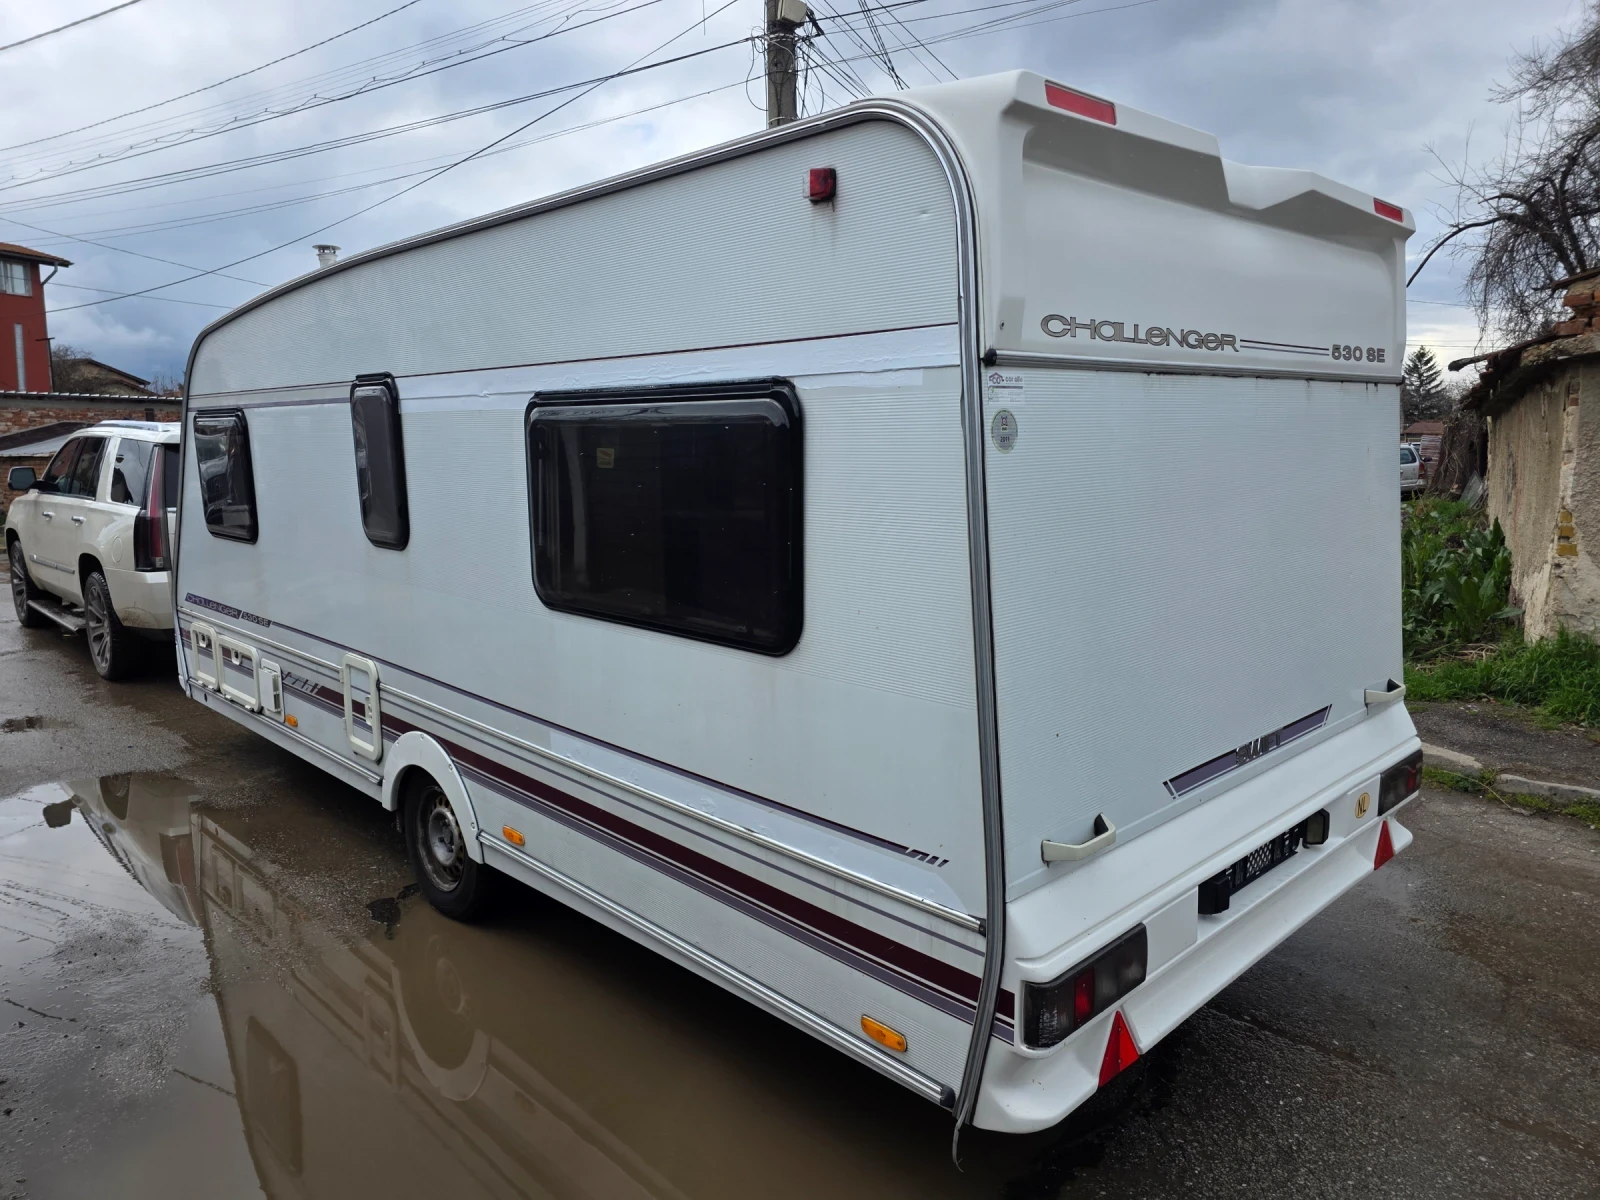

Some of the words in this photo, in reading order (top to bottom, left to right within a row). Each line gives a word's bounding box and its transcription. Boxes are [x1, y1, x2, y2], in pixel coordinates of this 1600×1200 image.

[1331, 344, 1363, 361] 530
[1366, 347, 1386, 363] SE
[243, 612, 258, 623] 530
[258, 616, 270, 627] SE
[1356, 795, 1367, 817] NL
